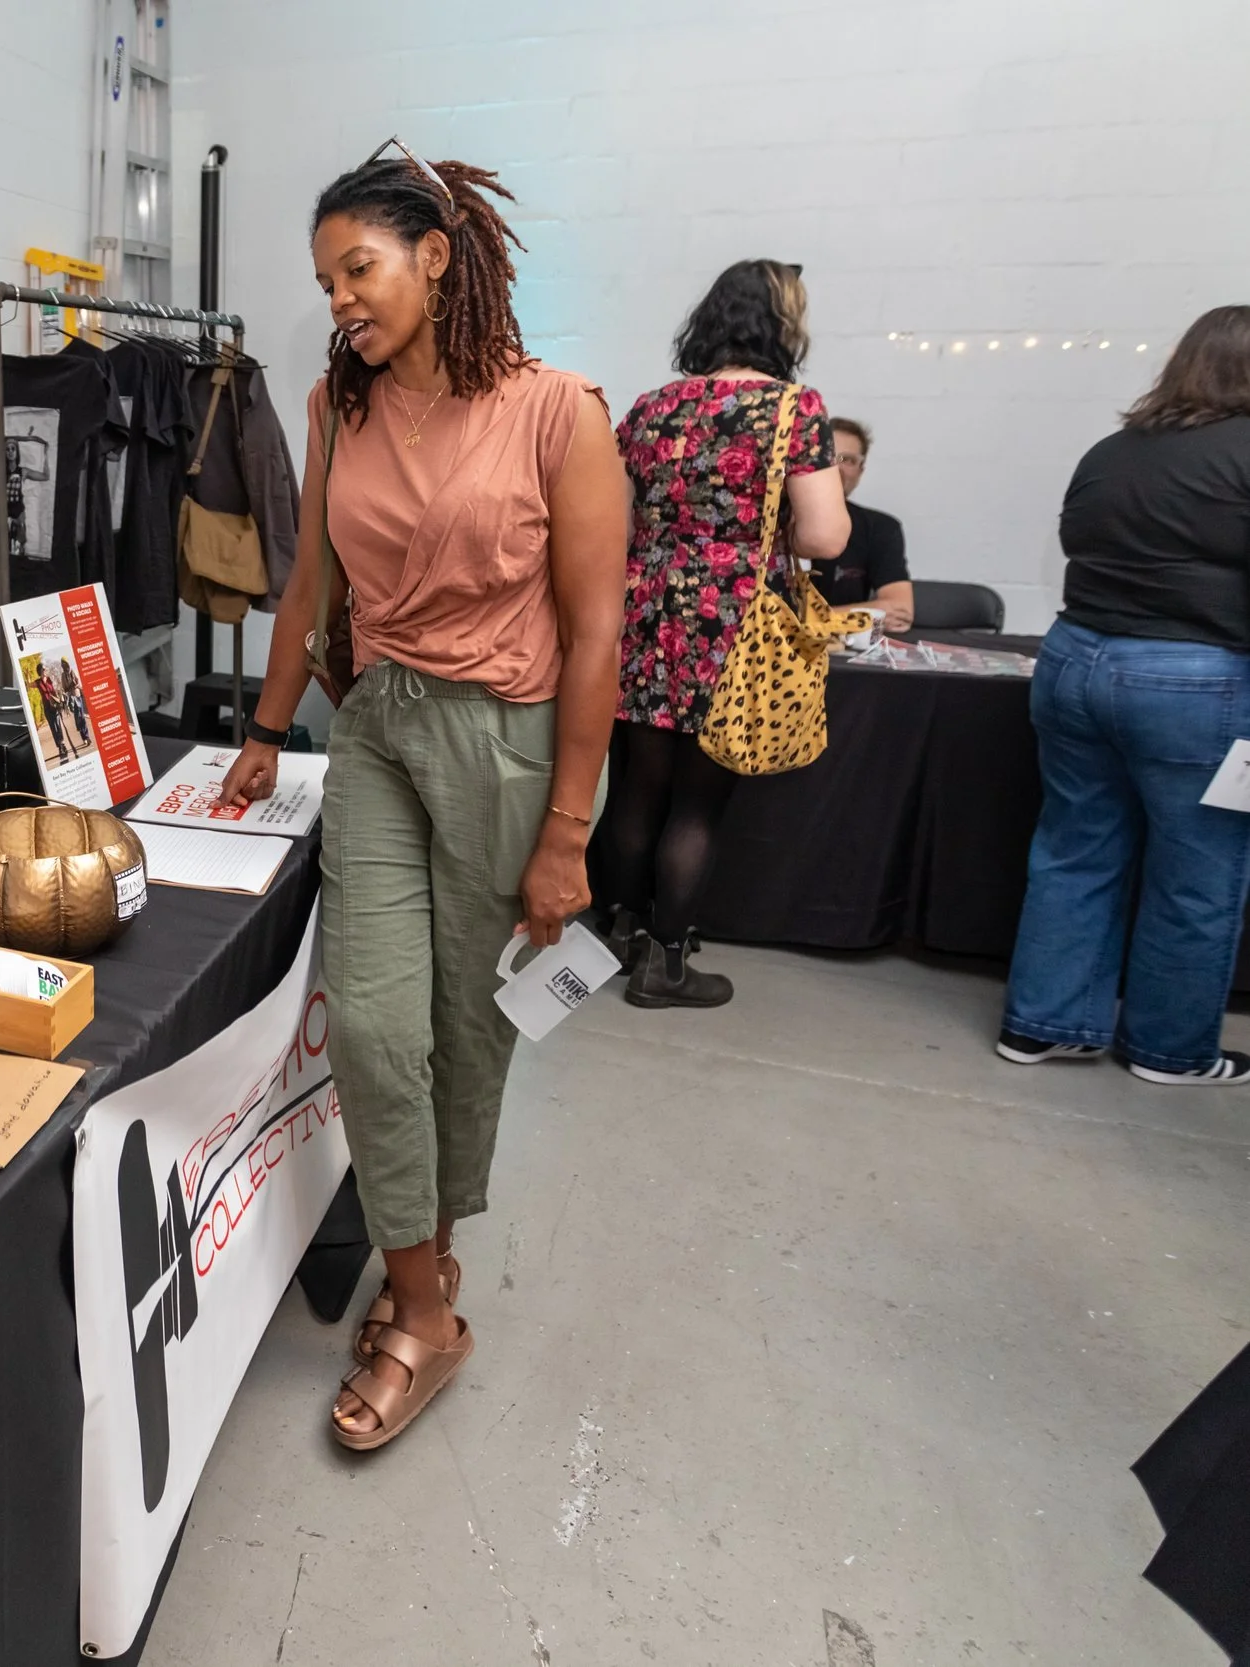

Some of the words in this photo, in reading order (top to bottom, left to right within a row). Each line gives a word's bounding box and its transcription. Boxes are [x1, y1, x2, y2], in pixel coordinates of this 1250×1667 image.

[67, 605, 81, 613] PHOTO
[80, 601, 94, 609] WALKS
[76, 608, 92, 617] SOCIALS
[41, 620, 62, 632] PHOTO
[77, 641, 104, 654] PHOTOGRAPHY
[80, 648, 104, 660] WORKSHOPS
[93, 682, 109, 693] GALLERY
[98, 714, 121, 728] COMMUNITY
[100, 721, 122, 734] DARKROOM
[107, 757, 125, 769] CONTACT
[156, 783, 197, 815] EBPCO
[182, 784, 222, 818] MERCH
[38, 966, 64, 988] EAST
[557, 972, 589, 1001] MIKE
[195, 1085, 344, 1277] COLLECTIVE
